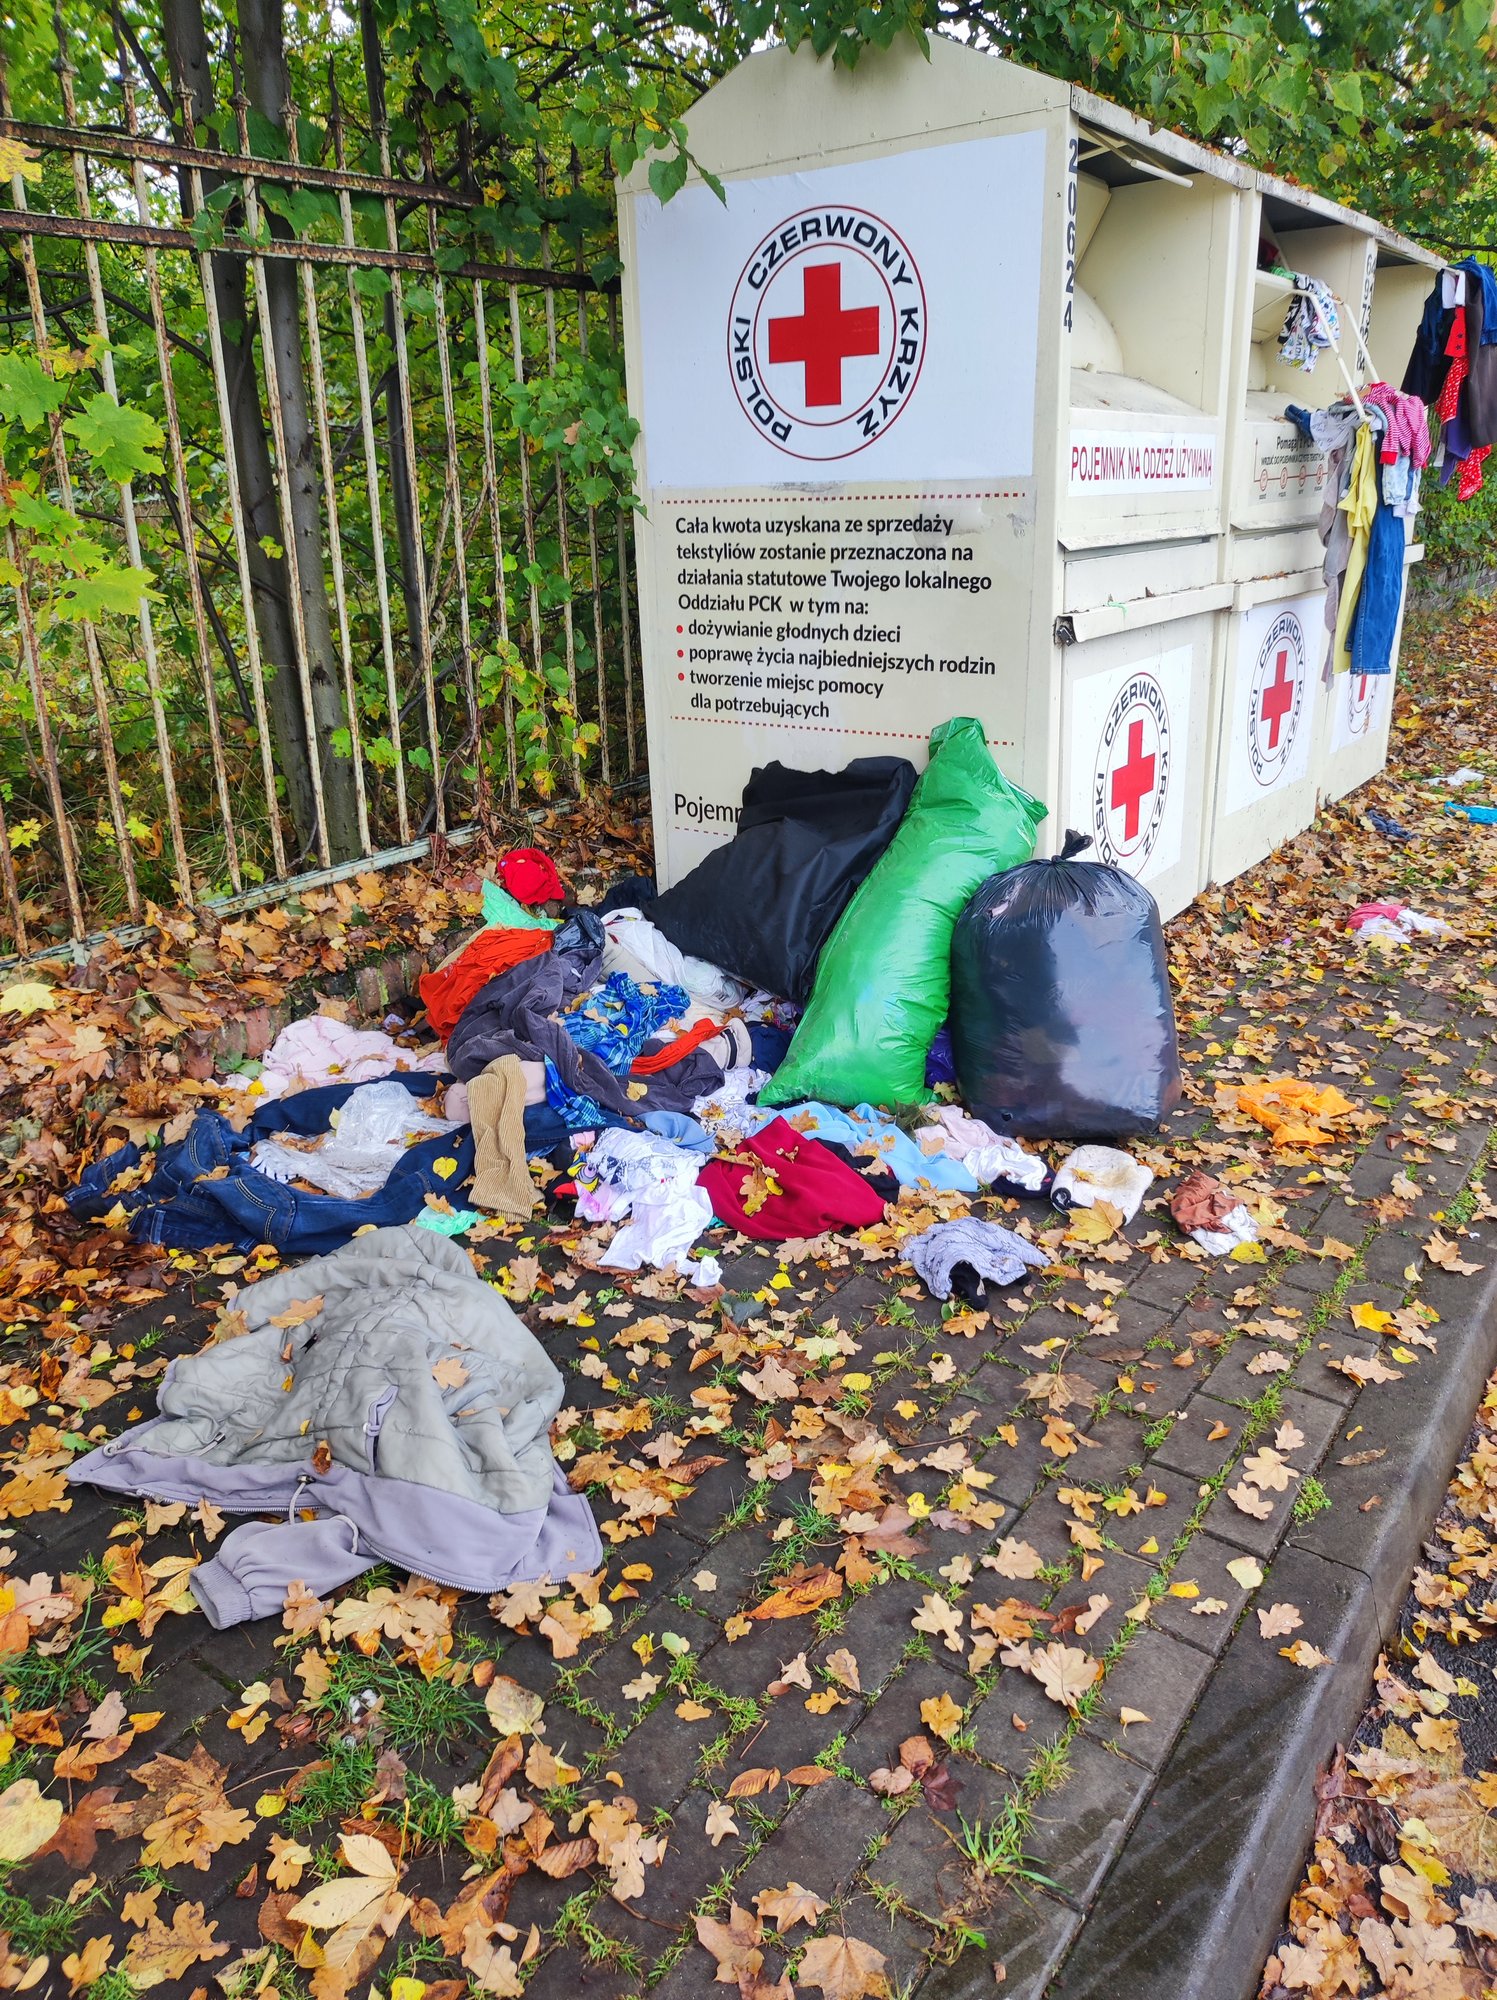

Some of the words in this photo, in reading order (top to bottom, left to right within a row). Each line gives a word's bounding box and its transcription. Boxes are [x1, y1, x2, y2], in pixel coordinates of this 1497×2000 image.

[747, 214, 914, 290] CZERWONY
[734, 316, 793, 442] POLSKI
[856, 306, 919, 438] KRZYŻ
[1070, 446, 1126, 481] POJEMNIK
[1127, 446, 1141, 480] NA
[675, 516, 709, 534] Cała
[712, 516, 762, 534] kwota
[765, 515, 841, 537] uzyskana
[844, 519, 863, 533] ze
[866, 513, 954, 537] sprzedaży
[676, 542, 756, 563] tekstyliów
[759, 542, 826, 560] zostanie
[830, 547, 947, 564] przeznaczona
[951, 547, 973, 561] na
[677, 568, 743, 586] działania
[746, 570, 827, 587] statutowe
[830, 569, 901, 592] Twojego
[905, 570, 992, 594] lokalnego
[678, 593, 745, 612] Oddziału
[748, 595, 783, 613] PCK
[789, 600, 805, 613] w
[807, 597, 840, 617] tym
[844, 601, 869, 615] na:
[688, 618, 773, 640] dożywianie
[776, 621, 849, 644] głodnych
[853, 624, 901, 643] dzieci
[1259, 617, 1304, 669] CZERWONY
[689, 648, 753, 666] poprawę
[756, 646, 795, 667] życia
[798, 649, 935, 674] najbiedniejszych
[939, 655, 996, 675] rodzin
[689, 669, 763, 688] tworzenie
[766, 673, 815, 694] miejsc
[818, 680, 884, 699] pomocy
[690, 692, 712, 709] dla
[715, 696, 830, 720] potrzebujących
[1104, 680, 1168, 748] CZERWONY
